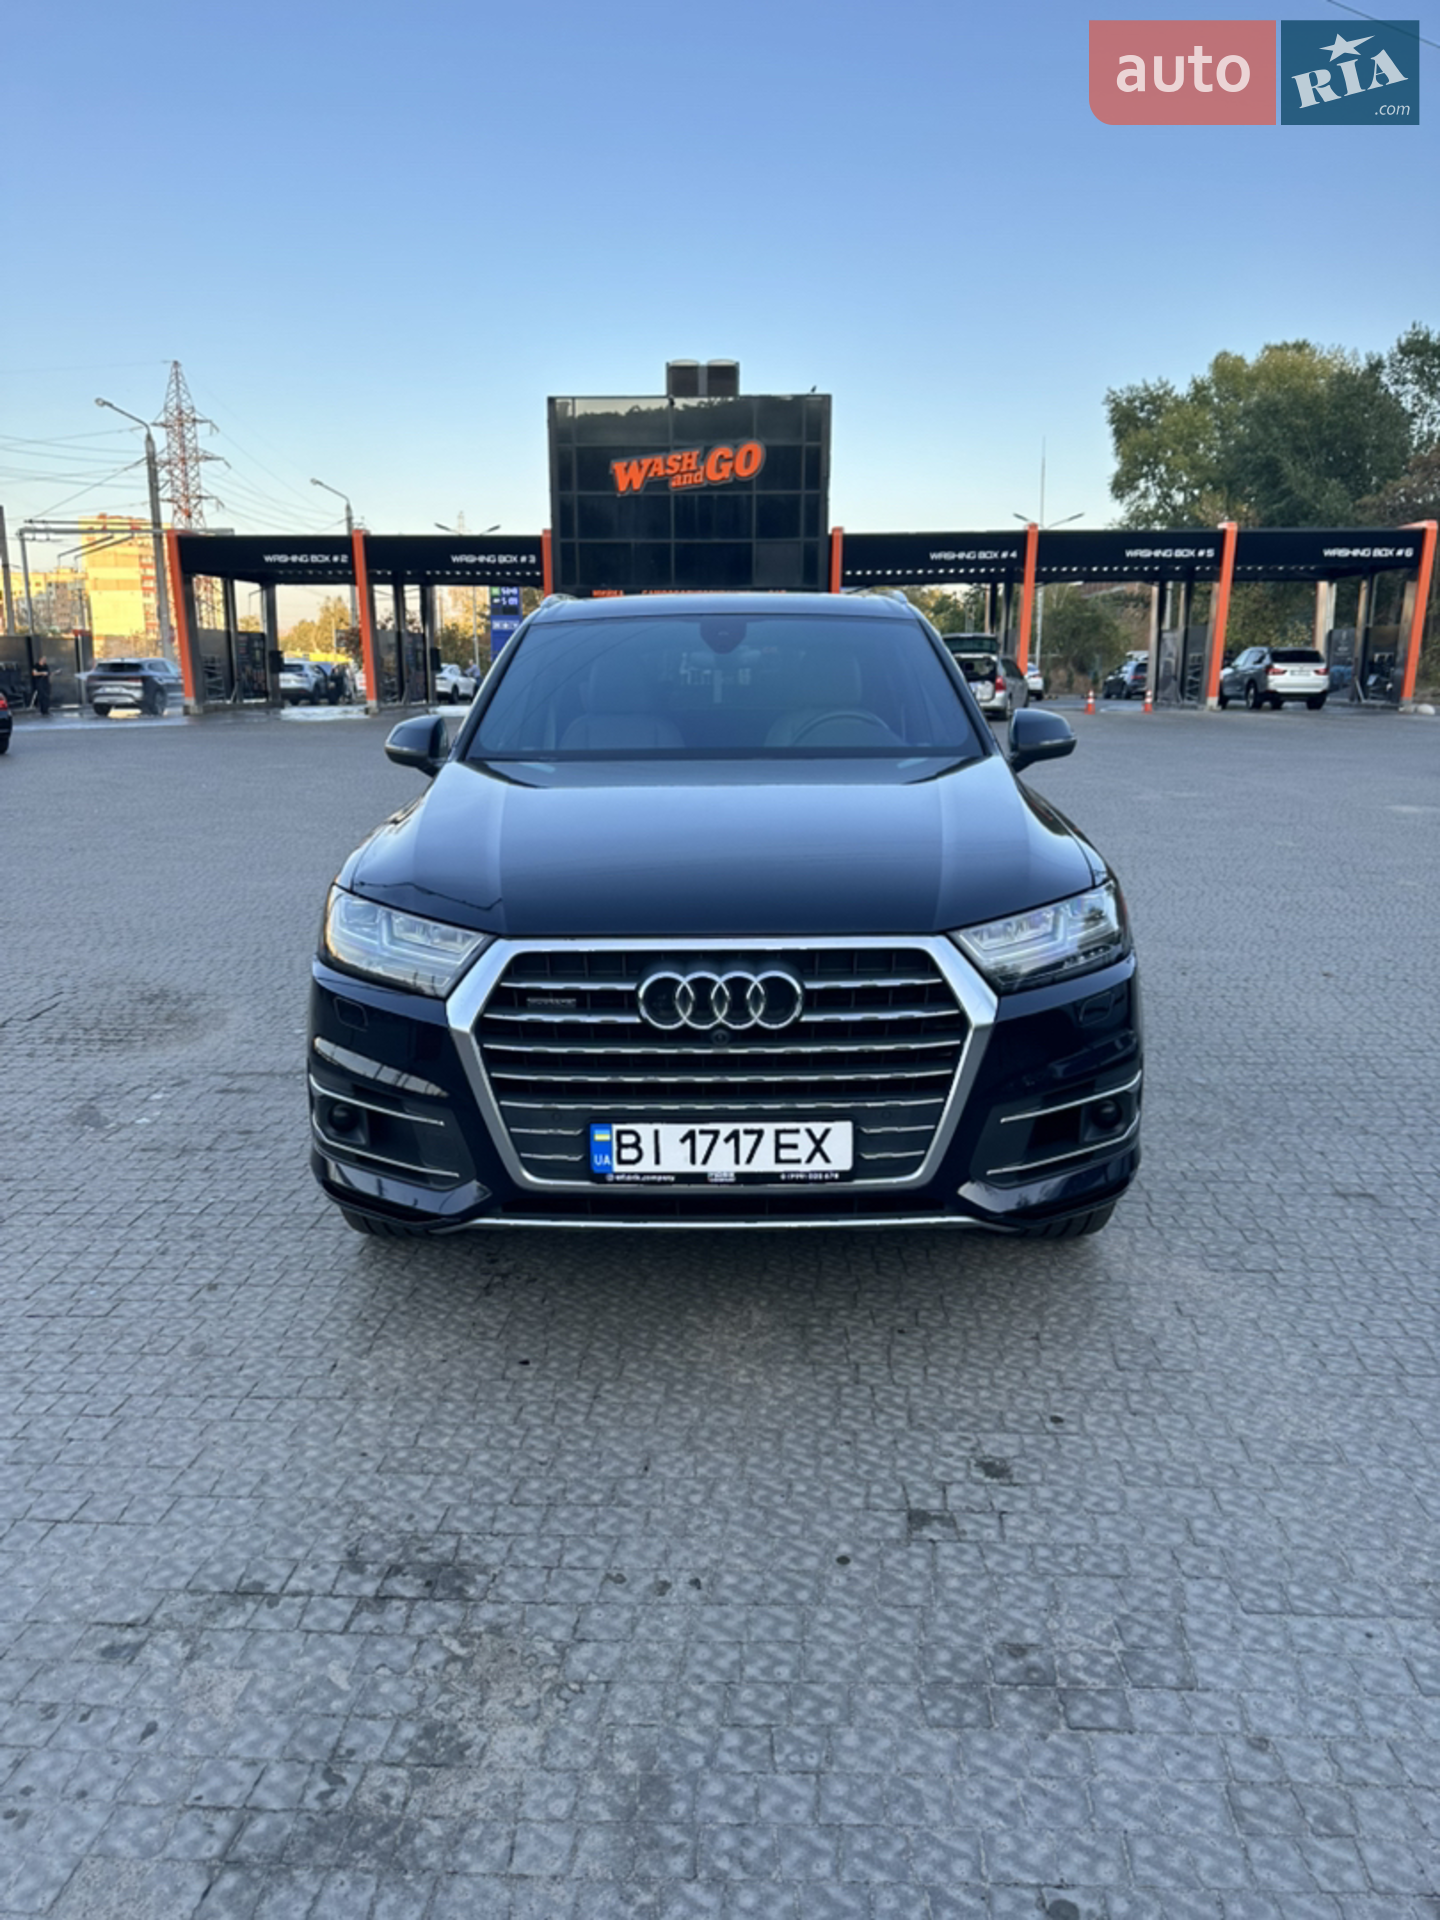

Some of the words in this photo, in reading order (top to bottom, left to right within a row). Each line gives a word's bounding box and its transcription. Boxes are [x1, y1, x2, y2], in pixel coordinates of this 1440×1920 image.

[612, 450, 700, 494] WASH
[670, 464, 704, 488] and
[706, 440, 763, 482] GO
[929, 550, 977, 560] WASHING
[977, 550, 999, 560] BOX
[1125, 548, 1173, 558] WASHING
[1174, 547, 1196, 558] BOX
[1322, 547, 1372, 558] WASHING
[1372, 547, 1395, 558] BOX
[263, 554, 309, 563] WASHING
[310, 554, 332, 563] BOX
[450, 554, 497, 564] WASHING
[497, 554, 519, 564] BOX
[615, 1129, 661, 1165] BI
[679, 1129, 765, 1165] 1717
[774, 1128, 832, 1165] EX
[594, 1154, 612, 1167] UA
